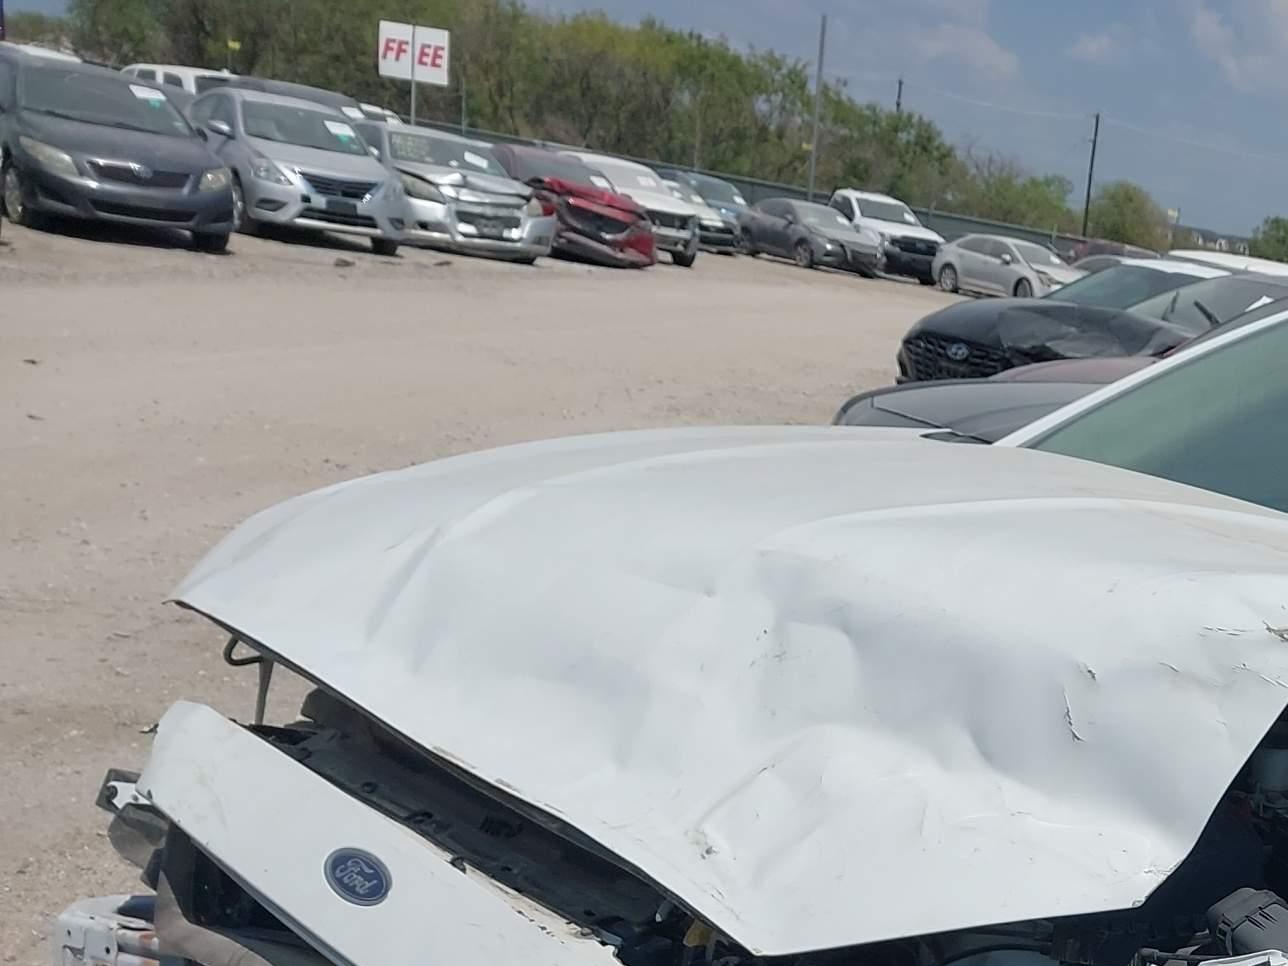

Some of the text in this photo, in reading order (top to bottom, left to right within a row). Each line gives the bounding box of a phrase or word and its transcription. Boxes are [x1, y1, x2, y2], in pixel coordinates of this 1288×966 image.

[382, 37, 445, 68] FF EE
[335, 858, 378, 894] Ford
